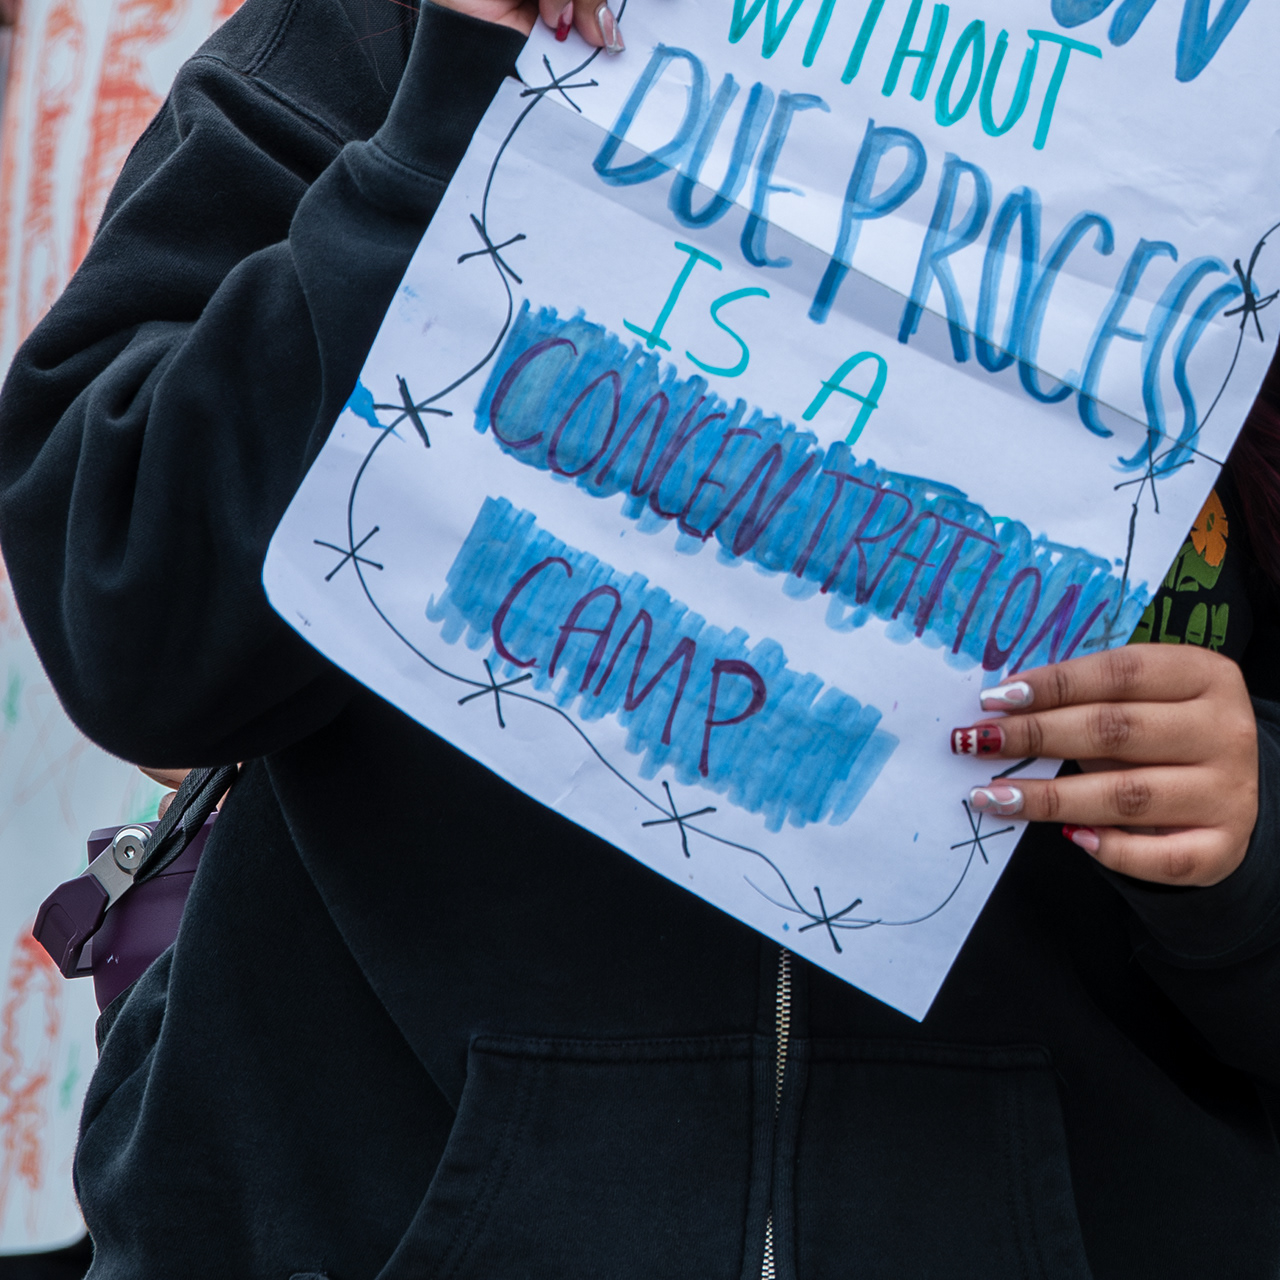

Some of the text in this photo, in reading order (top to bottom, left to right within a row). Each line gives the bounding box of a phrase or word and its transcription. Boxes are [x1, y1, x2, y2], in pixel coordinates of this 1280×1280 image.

[592, 42, 832, 269] DUE
[807, 117, 1262, 481] PROCESS
[622, 240, 889, 447] IS A
[488, 336, 1112, 678] CONCENTRATION
[490, 555, 768, 778] CAMP
